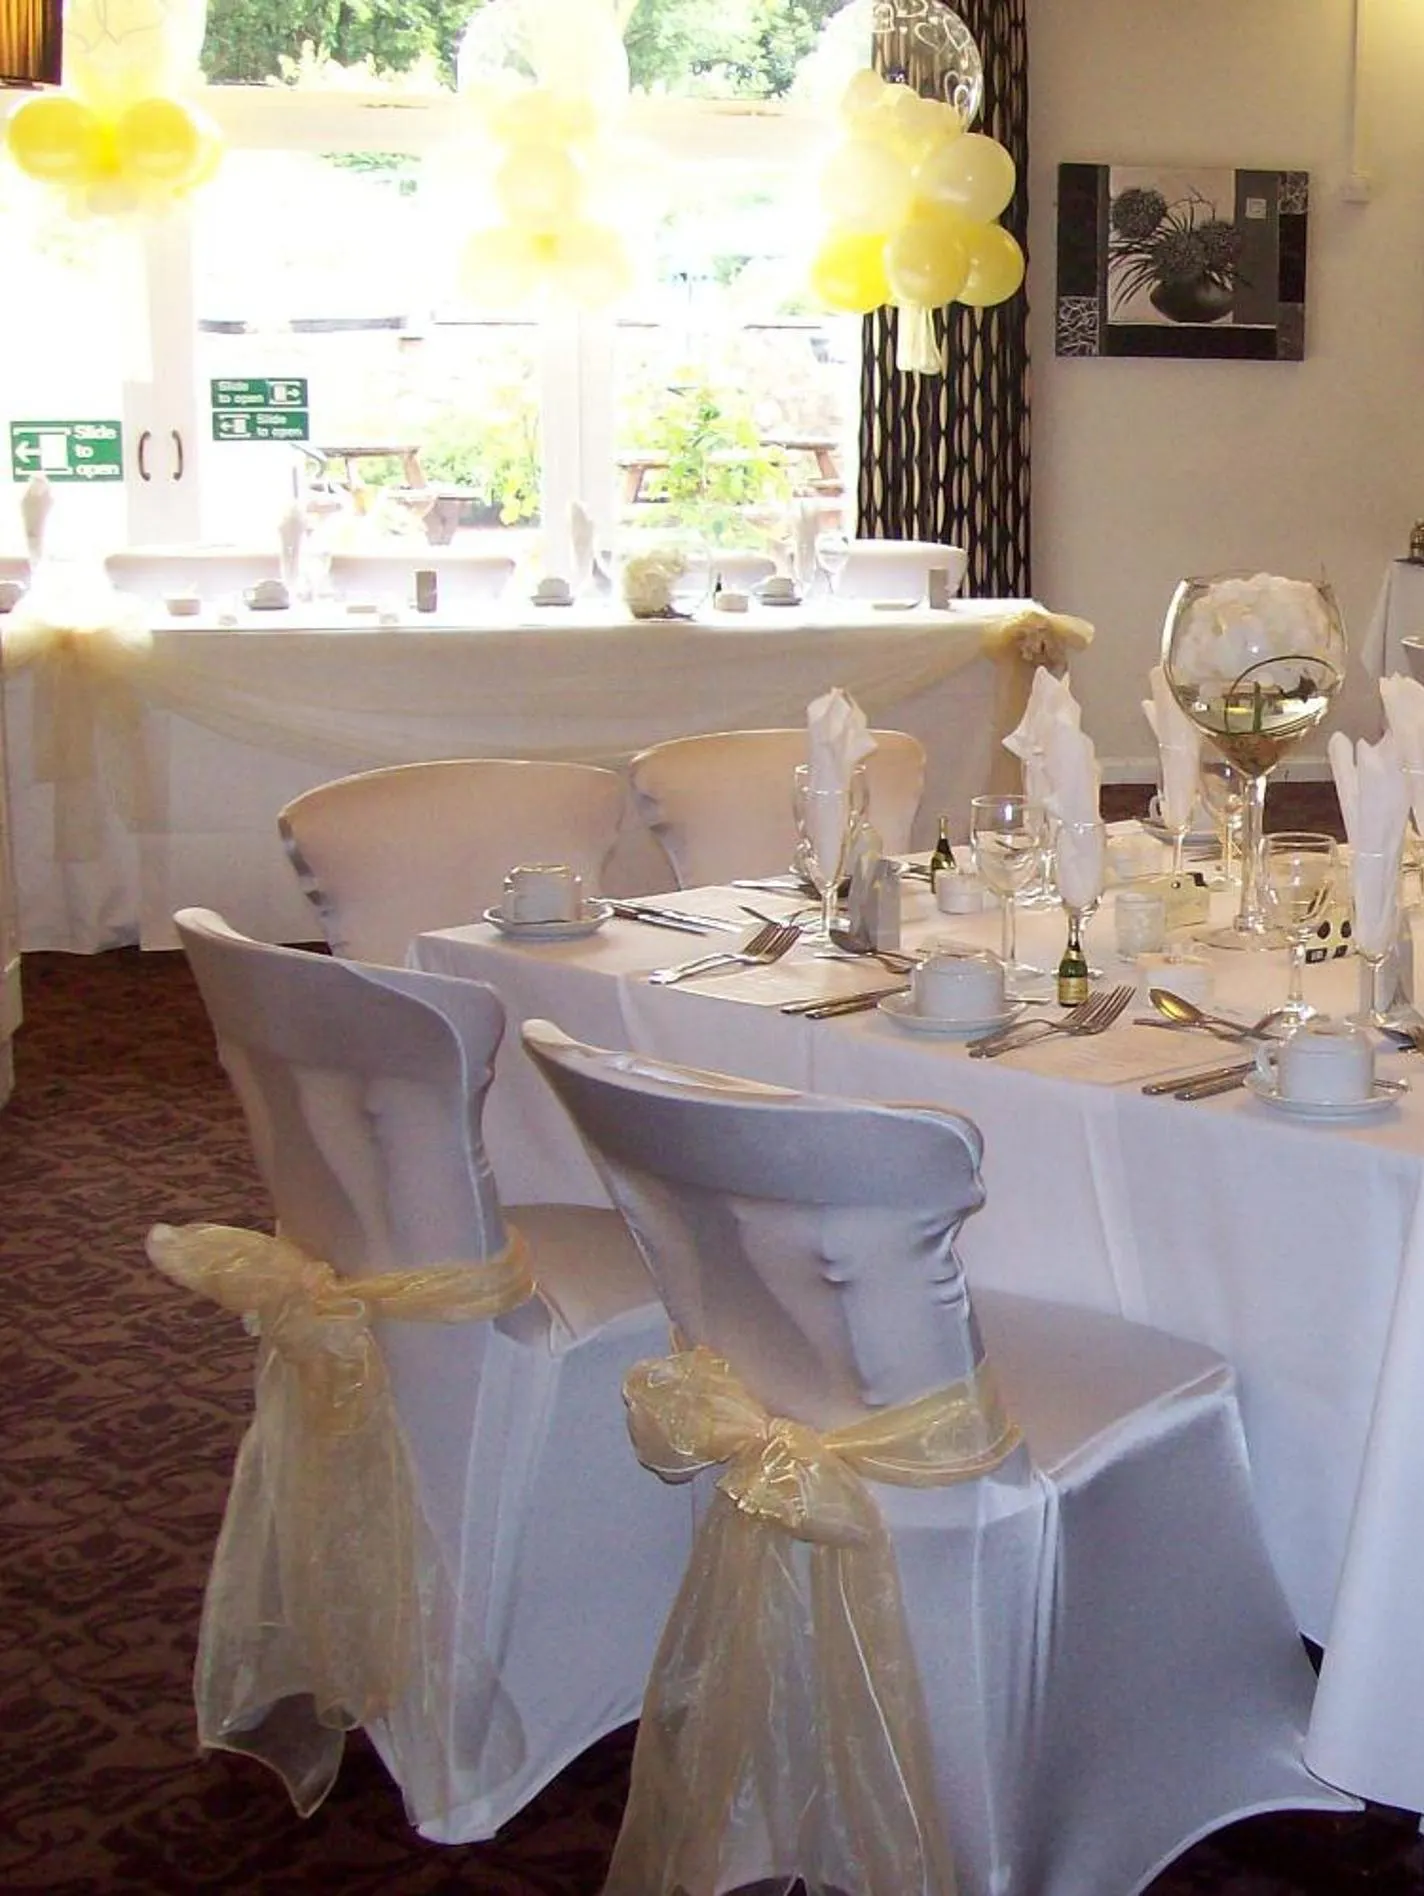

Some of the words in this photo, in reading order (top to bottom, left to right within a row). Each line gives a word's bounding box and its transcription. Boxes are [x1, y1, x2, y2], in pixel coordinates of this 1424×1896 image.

[218, 380, 249, 392] Slide
[218, 394, 231, 403] to
[233, 394, 264, 405] open
[256, 413, 287, 424] Slide
[73, 424, 116, 439] Slide
[256, 427, 269, 437] to
[271, 427, 303, 439] open
[75, 443, 94, 458] to
[75, 464, 119, 480] open
